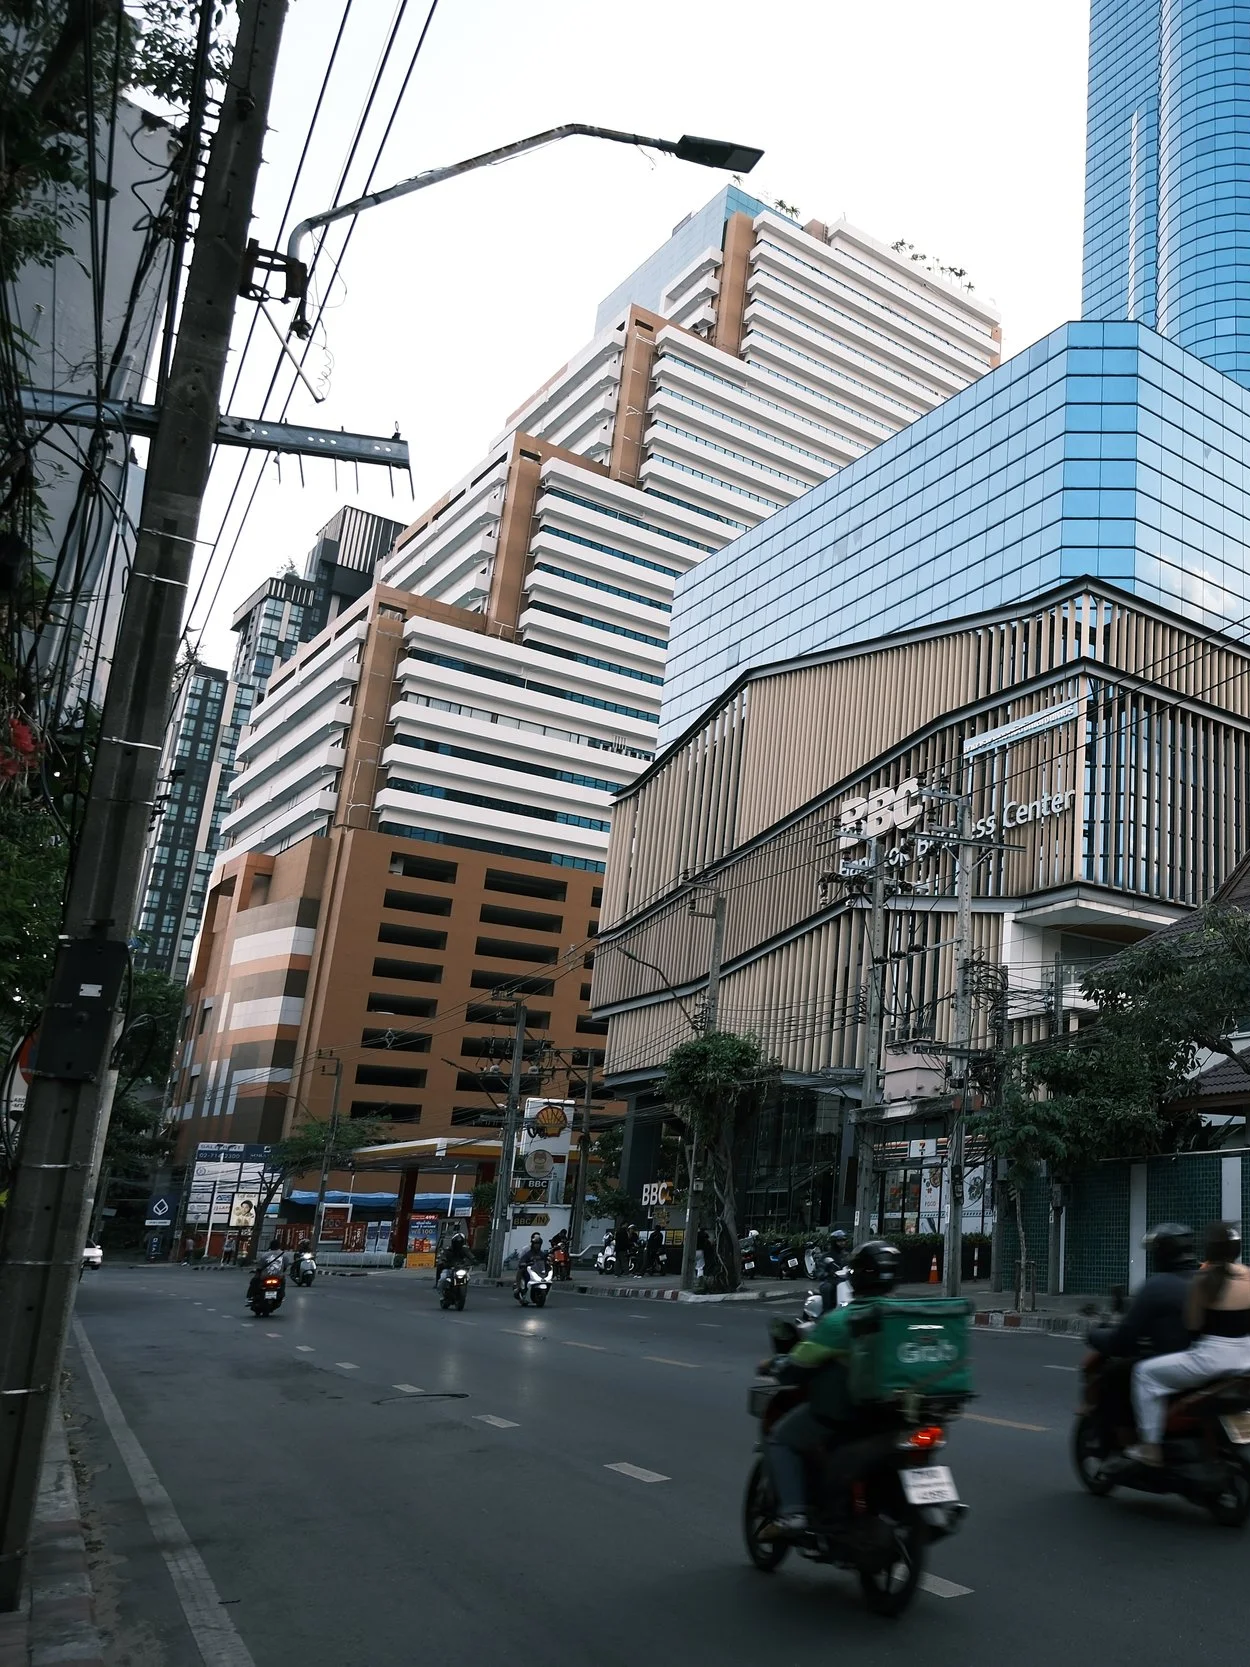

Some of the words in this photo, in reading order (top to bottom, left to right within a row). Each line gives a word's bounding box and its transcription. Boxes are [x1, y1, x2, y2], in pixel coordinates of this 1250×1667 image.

[840, 778, 923, 850] BBC
[1003, 789, 1076, 828] Center
[528, 1180, 548, 1188] BBC
[641, 1182, 668, 1206] BBC
[513, 1216, 532, 1226] BBC
[535, 1214, 546, 1224] IN
[897, 1339, 958, 1364] Grab
